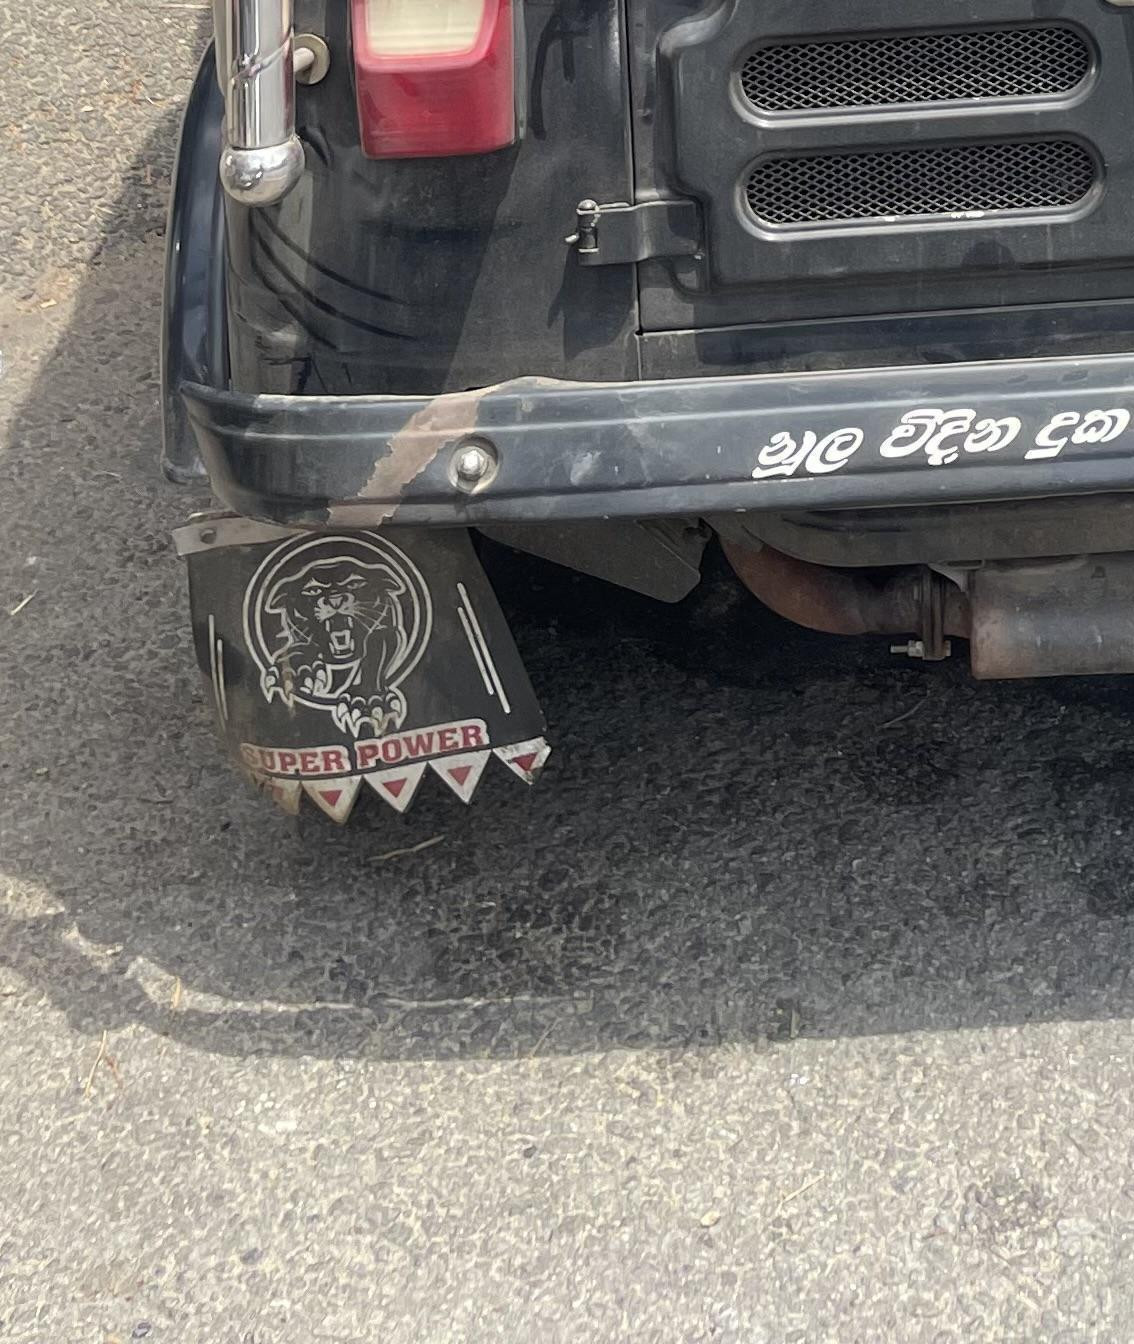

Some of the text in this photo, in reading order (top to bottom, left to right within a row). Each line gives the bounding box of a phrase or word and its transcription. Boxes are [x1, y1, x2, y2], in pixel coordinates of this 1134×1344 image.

[1024, 408, 1132, 461] දුක
[240, 723, 487, 776] SUPER POWER
